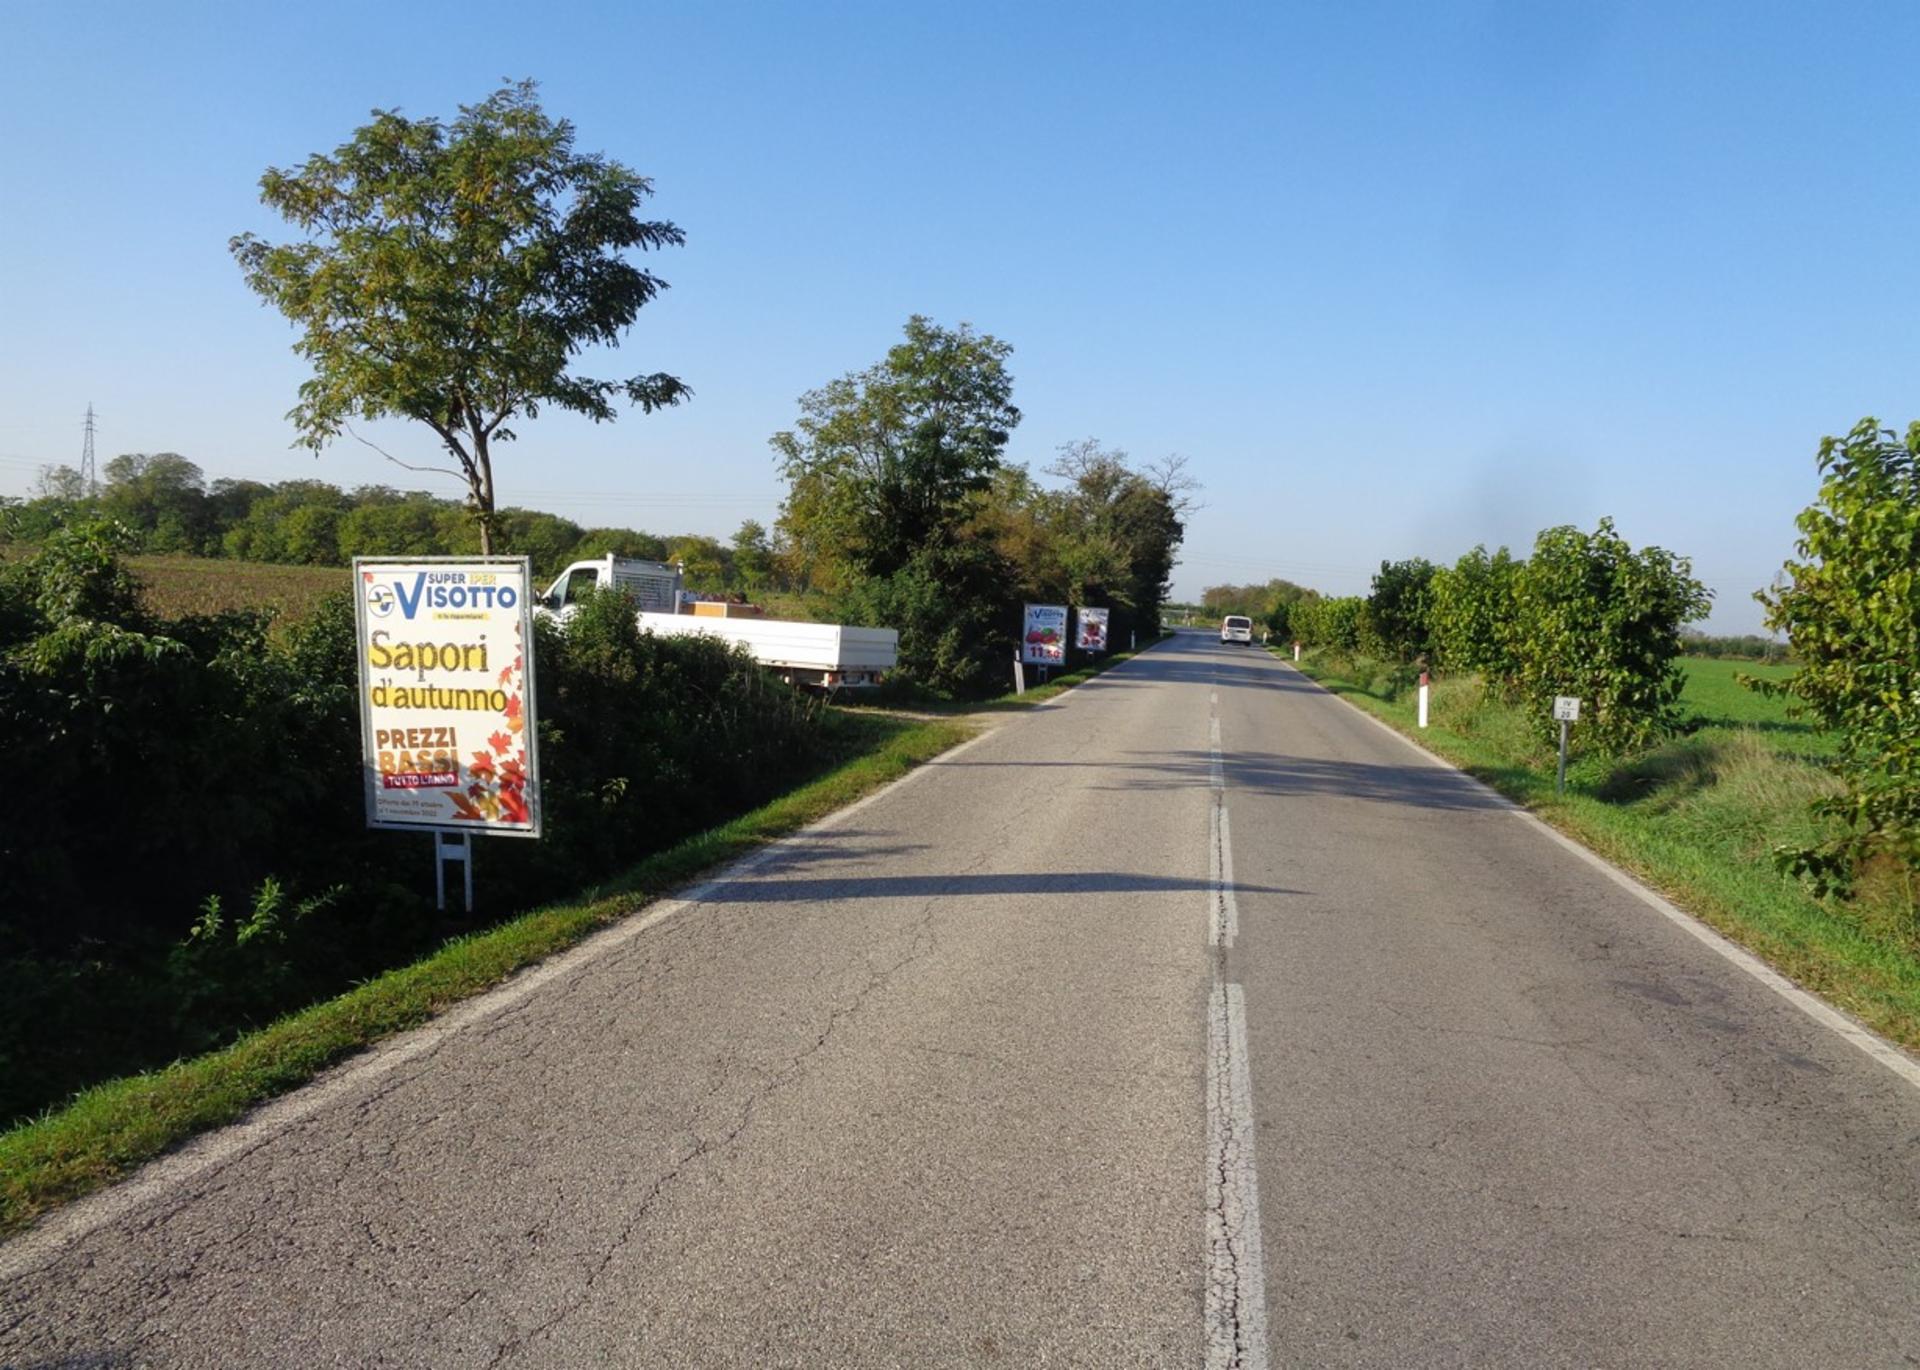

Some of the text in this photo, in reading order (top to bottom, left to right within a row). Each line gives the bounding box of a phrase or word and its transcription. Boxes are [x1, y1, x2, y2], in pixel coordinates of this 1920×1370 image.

[428, 573, 466, 585] SUPER
[394, 572, 517, 620] VISOTTO
[371, 629, 489, 682] Sapori
[372, 677, 508, 712] d'autunno
[376, 727, 457, 749] PREZZI
[378, 749, 460, 775] BASSI
[388, 775, 419, 787] TUTTO
